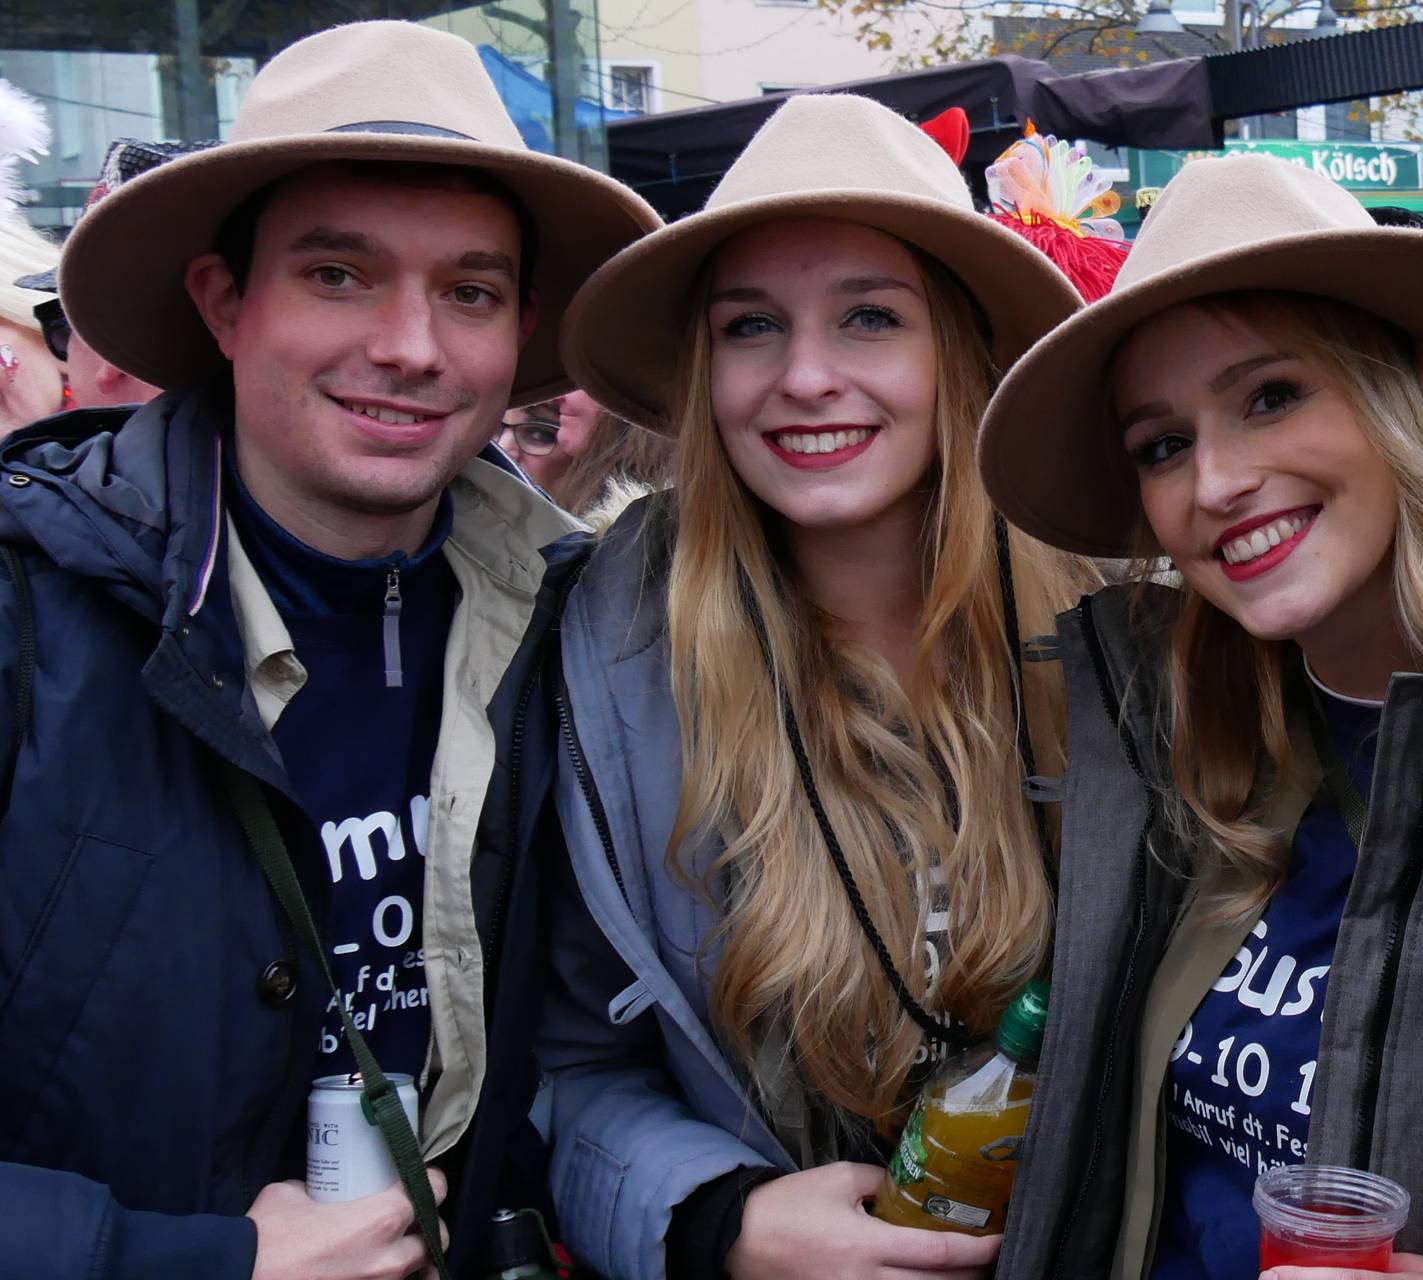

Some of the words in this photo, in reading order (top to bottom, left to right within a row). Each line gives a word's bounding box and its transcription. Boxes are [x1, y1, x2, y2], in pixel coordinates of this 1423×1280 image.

[1312, 149, 1397, 186] Kölsch
[1183, 1089, 1235, 1130] Anruf
[1219, 1136, 1250, 1168] viel
